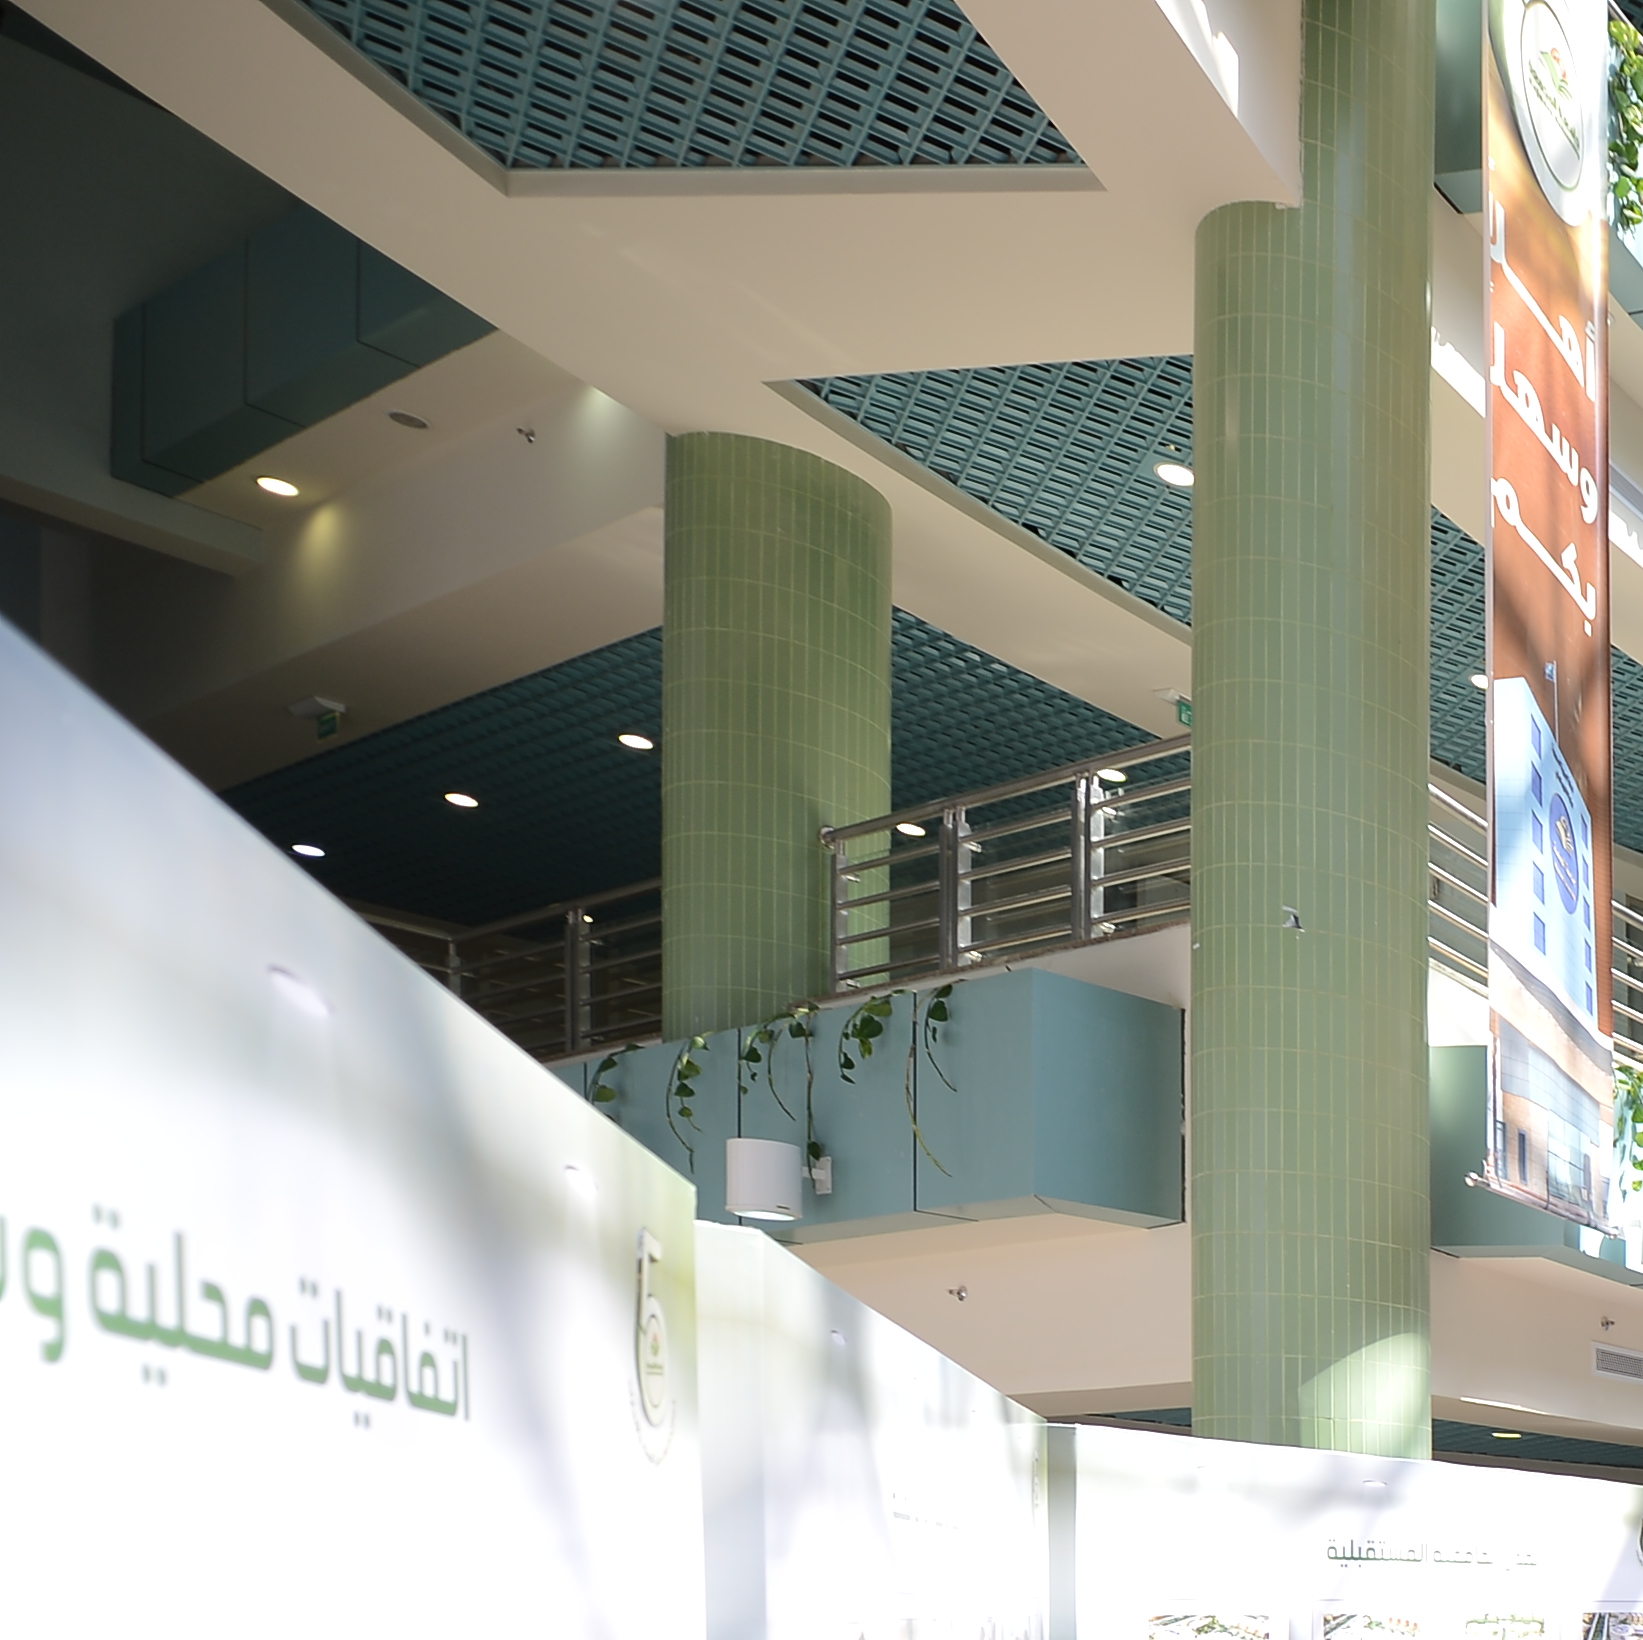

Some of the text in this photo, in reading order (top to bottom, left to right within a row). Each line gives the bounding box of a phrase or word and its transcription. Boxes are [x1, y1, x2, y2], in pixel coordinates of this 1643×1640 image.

[1489, 320, 1599, 525] وسهل
[88, 1203, 274, 1386] محلية
[289, 1276, 470, 1428] اتفاقيات
